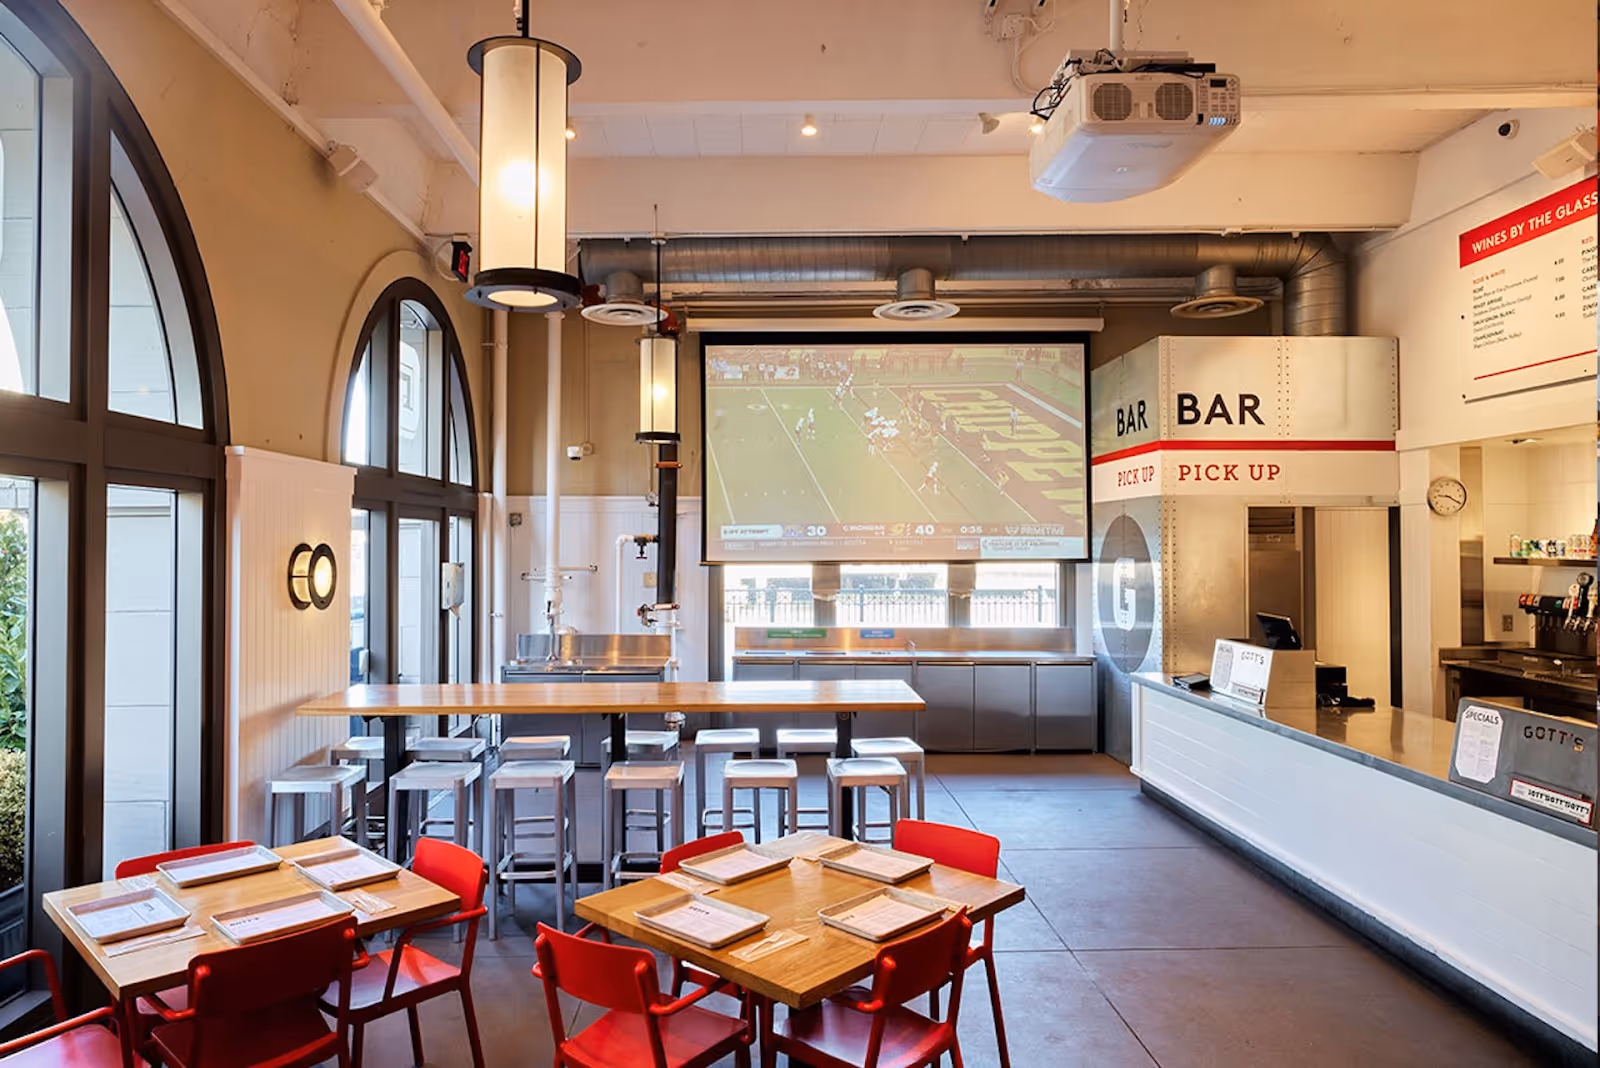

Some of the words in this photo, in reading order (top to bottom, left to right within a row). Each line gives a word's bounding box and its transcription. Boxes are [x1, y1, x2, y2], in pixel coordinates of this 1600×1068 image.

[1472, 230, 1507, 254] WINES
[1510, 223, 1524, 239] BY
[1528, 211, 1552, 231] THE
[1555, 192, 1598, 220] GLASS
[1116, 400, 1148, 437] BAR
[1177, 393, 1265, 426] BAR
[1118, 468, 1140, 487] PICK
[1142, 465, 1155, 482] UP
[1178, 464, 1239, 481] PICK
[1249, 464, 1280, 481] UP
[806, 526, 826, 536] 30
[915, 525, 935, 536] 40
[1465, 710, 1499, 724] SPECIALS
[1524, 726, 1584, 752] GOTT'S
